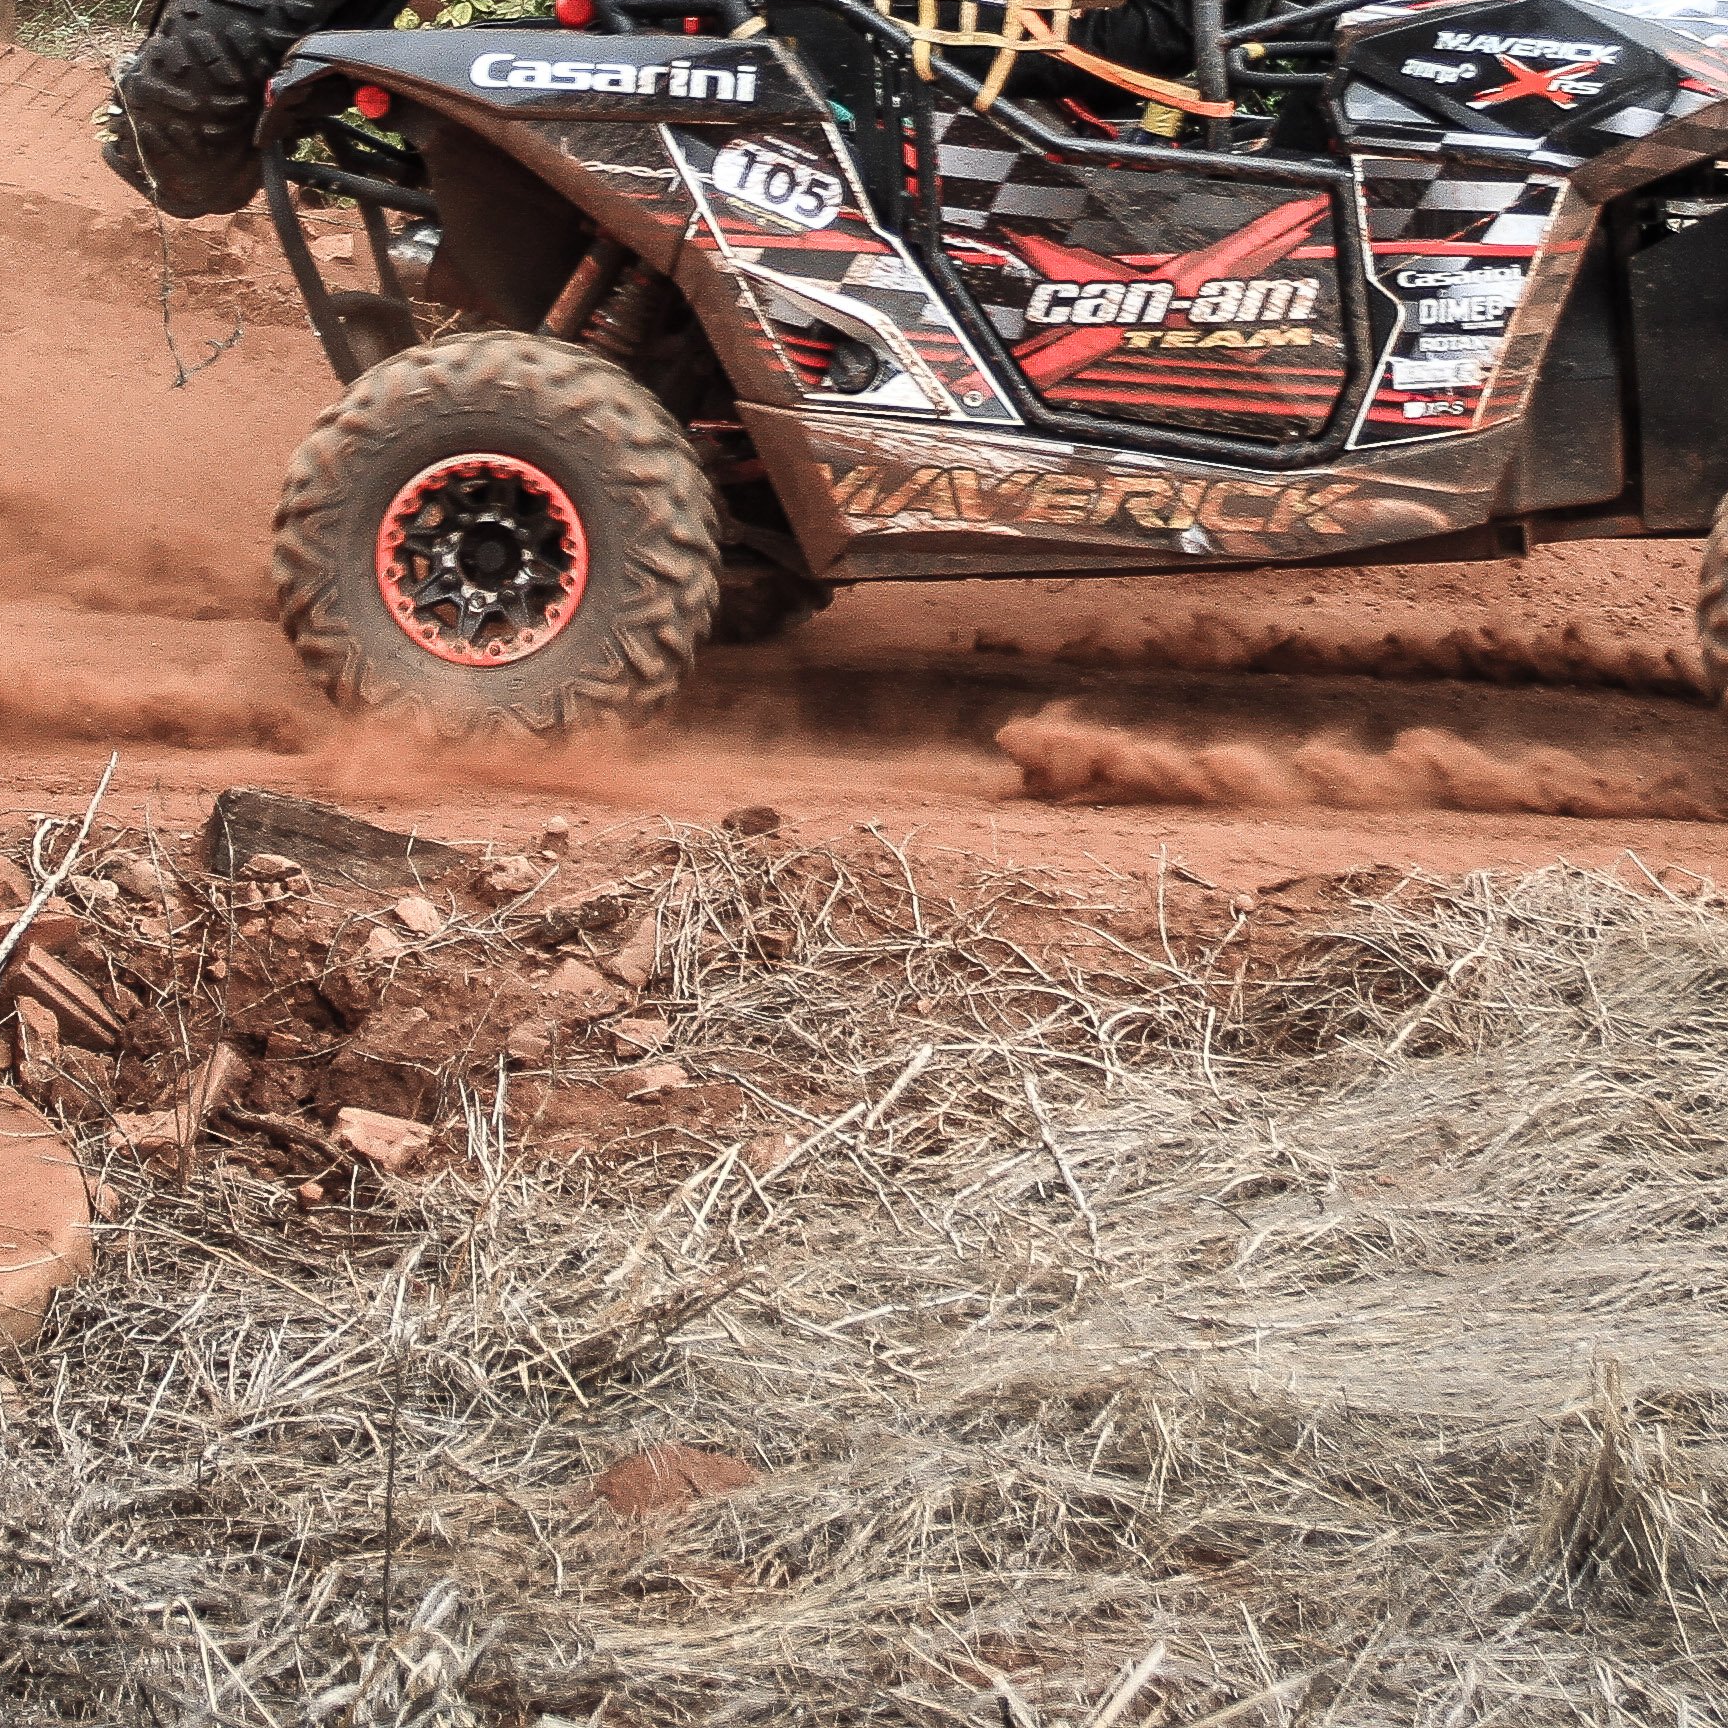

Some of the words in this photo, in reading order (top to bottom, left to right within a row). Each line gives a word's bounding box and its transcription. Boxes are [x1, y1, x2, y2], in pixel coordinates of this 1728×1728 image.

[1433, 30, 1623, 64] MAVERICK
[469, 52, 759, 103] Casarini
[736, 148, 830, 218] 105
[1396, 263, 1522, 288] Casarini
[1024, 277, 1321, 324] can-am
[1123, 325, 1314, 349] TEAM
[815, 462, 1360, 536] MAVERICK
